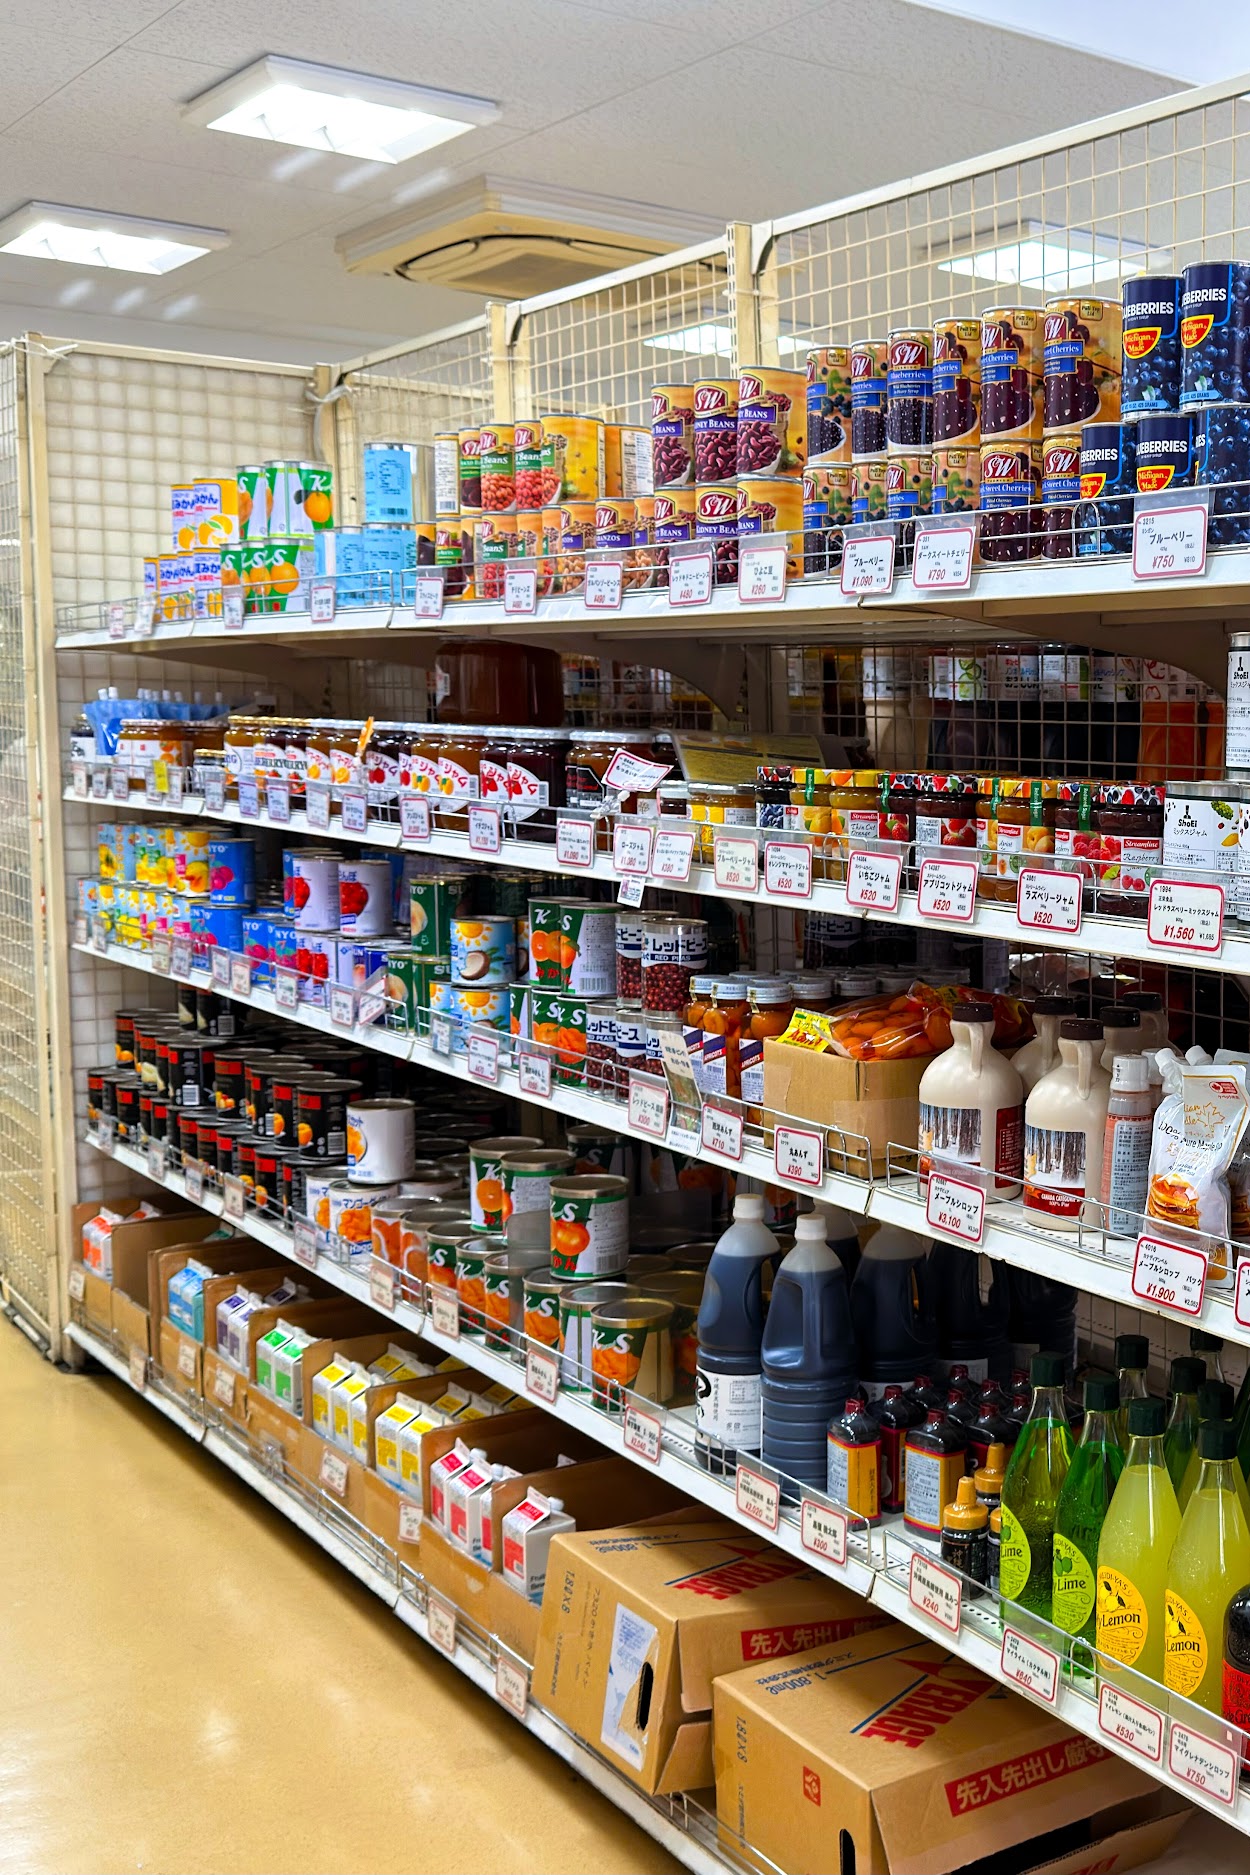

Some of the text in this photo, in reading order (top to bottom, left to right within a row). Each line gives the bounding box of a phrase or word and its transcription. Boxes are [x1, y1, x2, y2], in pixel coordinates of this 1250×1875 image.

[710, 420, 735, 430] BEANS
[1149, 531, 1193, 546] ブルーベリー
[918, 548, 969, 561] ダークスイートチェリー
[1152, 555, 1175, 568] ¥750
[852, 576, 873, 587] ¥1,090
[928, 568, 946, 581] ¥790
[1173, 828, 1208, 837] ミックスジャム
[1122, 853, 1159, 864] Raspberry
[777, 877, 792, 889] ¥520
[858, 870, 890, 883] いちごジャム
[923, 879, 973, 893] アプリコットジャム
[1159, 885, 1172, 893] 1994
[860, 889, 877, 901] ¥520
[1025, 891, 1074, 905] ラズベリージャム
[1153, 903, 1220, 918] レッドラズベリーミックスジャム
[1164, 924, 1194, 940] ¥1,560
[652, 938, 708, 954] レッドピース
[712, 1136, 726, 1148] ¥710
[933, 1191, 979, 1214] メープルシロップ
[938, 1209, 961, 1229] ¥3,100
[1146, 1282, 1176, 1302] ¥1,900
[813, 1537, 828, 1552] ¥300
[1058, 1576, 1087, 1590] Lime
[923, 1594, 940, 1616] ¥240
[1102, 1613, 1141, 1626] Lemon
[1166, 1638, 1200, 1653] Lemon
[1173, 1743, 1230, 1779] マイグレナデンシロップ
[1187, 1768, 1206, 1786] ¥750
